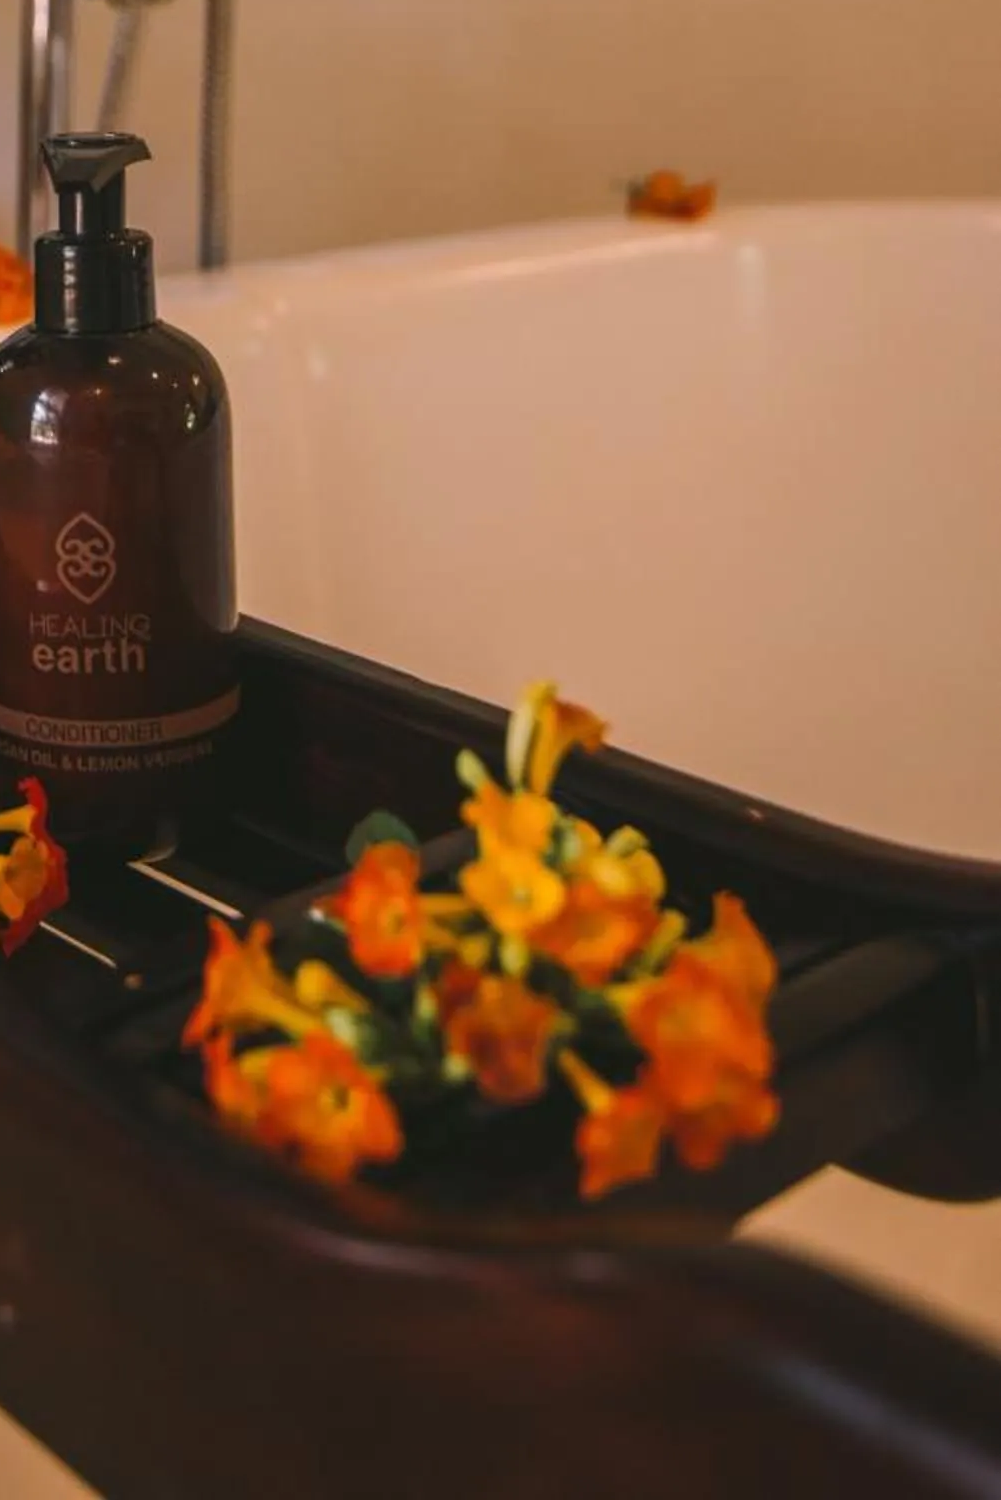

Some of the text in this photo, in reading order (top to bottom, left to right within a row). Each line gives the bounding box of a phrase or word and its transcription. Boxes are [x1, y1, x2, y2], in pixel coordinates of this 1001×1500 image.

[29, 612, 151, 641] HEALING
[31, 638, 145, 674] earth
[25, 716, 162, 742] CONDITIONER
[30, 749, 57, 769] OIL
[76, 754, 139, 772] LEMON
